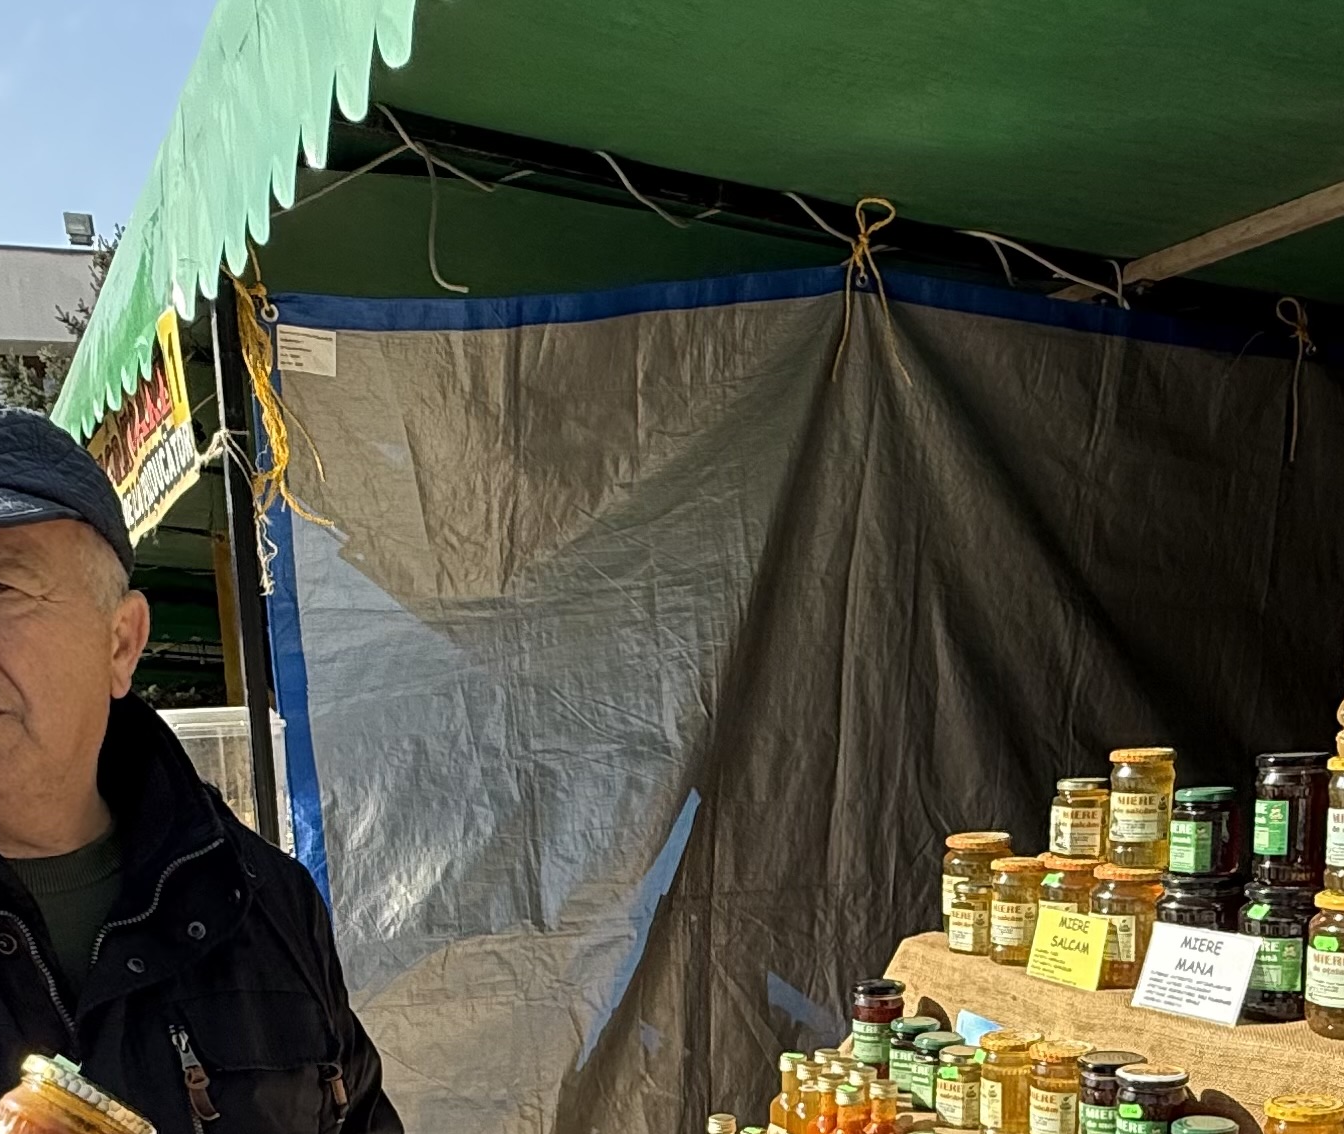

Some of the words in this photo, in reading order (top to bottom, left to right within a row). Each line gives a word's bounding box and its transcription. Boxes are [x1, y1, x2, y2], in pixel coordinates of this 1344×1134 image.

[1058, 916, 1090, 935] MIERE
[1050, 936, 1090, 956] SALCAM
[1180, 935, 1224, 956] MIERE
[1174, 957, 1215, 978] MANA
